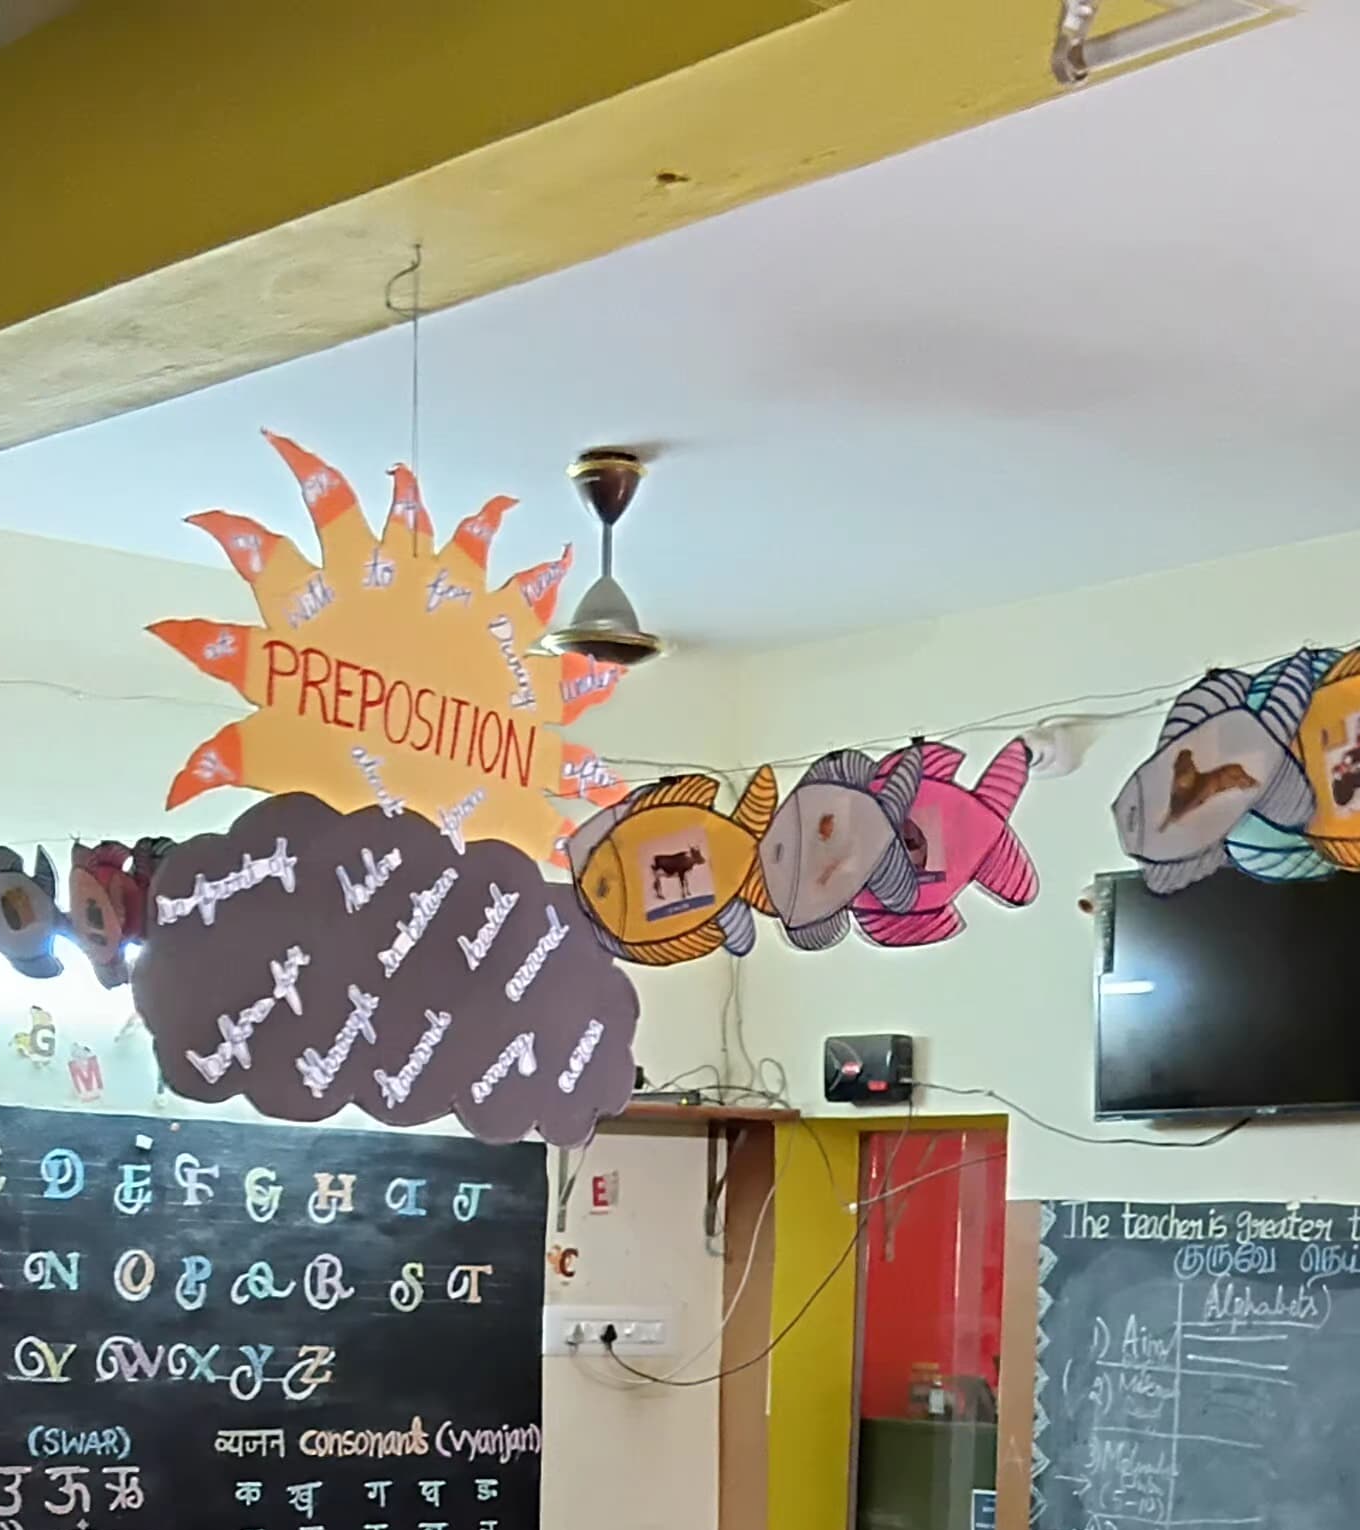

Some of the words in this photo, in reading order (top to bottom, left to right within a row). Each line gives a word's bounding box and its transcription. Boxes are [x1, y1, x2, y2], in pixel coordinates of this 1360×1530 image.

[362, 547, 394, 588] to
[426, 569, 473, 613] for
[205, 631, 235, 660] at
[262, 639, 536, 788] PREPOSITION
[505, 904, 570, 1002] around
[69, 1057, 103, 1095] M
[472, 1031, 537, 1104] among
[41, 1147, 85, 1200] D
[114, 1163, 153, 1215] E
[174, 1152, 220, 1206] F
[244, 1166, 283, 1223] G
[308, 1172, 357, 1224] H
[385, 1177, 427, 1216] I
[452, 1182, 492, 1222] J
[592, 1176, 609, 1207] E
[1063, 1201, 1110, 1240] The
[1121, 1204, 1206, 1240] teacher
[1236, 1209, 1333, 1244] greater
[23, 1250, 80, 1290] N
[113, 1248, 155, 1301] O
[175, 1255, 213, 1311] P
[230, 1260, 297, 1306] Q
[303, 1252, 355, 1311] R
[389, 1261, 424, 1312] S
[447, 1264, 494, 1303] T
[1174, 1245, 1277, 1280] குருவே
[14, 1335, 77, 1380] V
[96, 1335, 164, 1382] W
[168, 1343, 220, 1383] X
[229, 1344, 274, 1400] Y
[282, 1344, 336, 1400] Z
[27, 1424, 132, 1458] (SWAR)
[44, 1466, 91, 1514] ऊ
[102, 1465, 144, 1512] ऋ
[235, 1481, 263, 1507] क
[363, 1480, 393, 1508] ग
